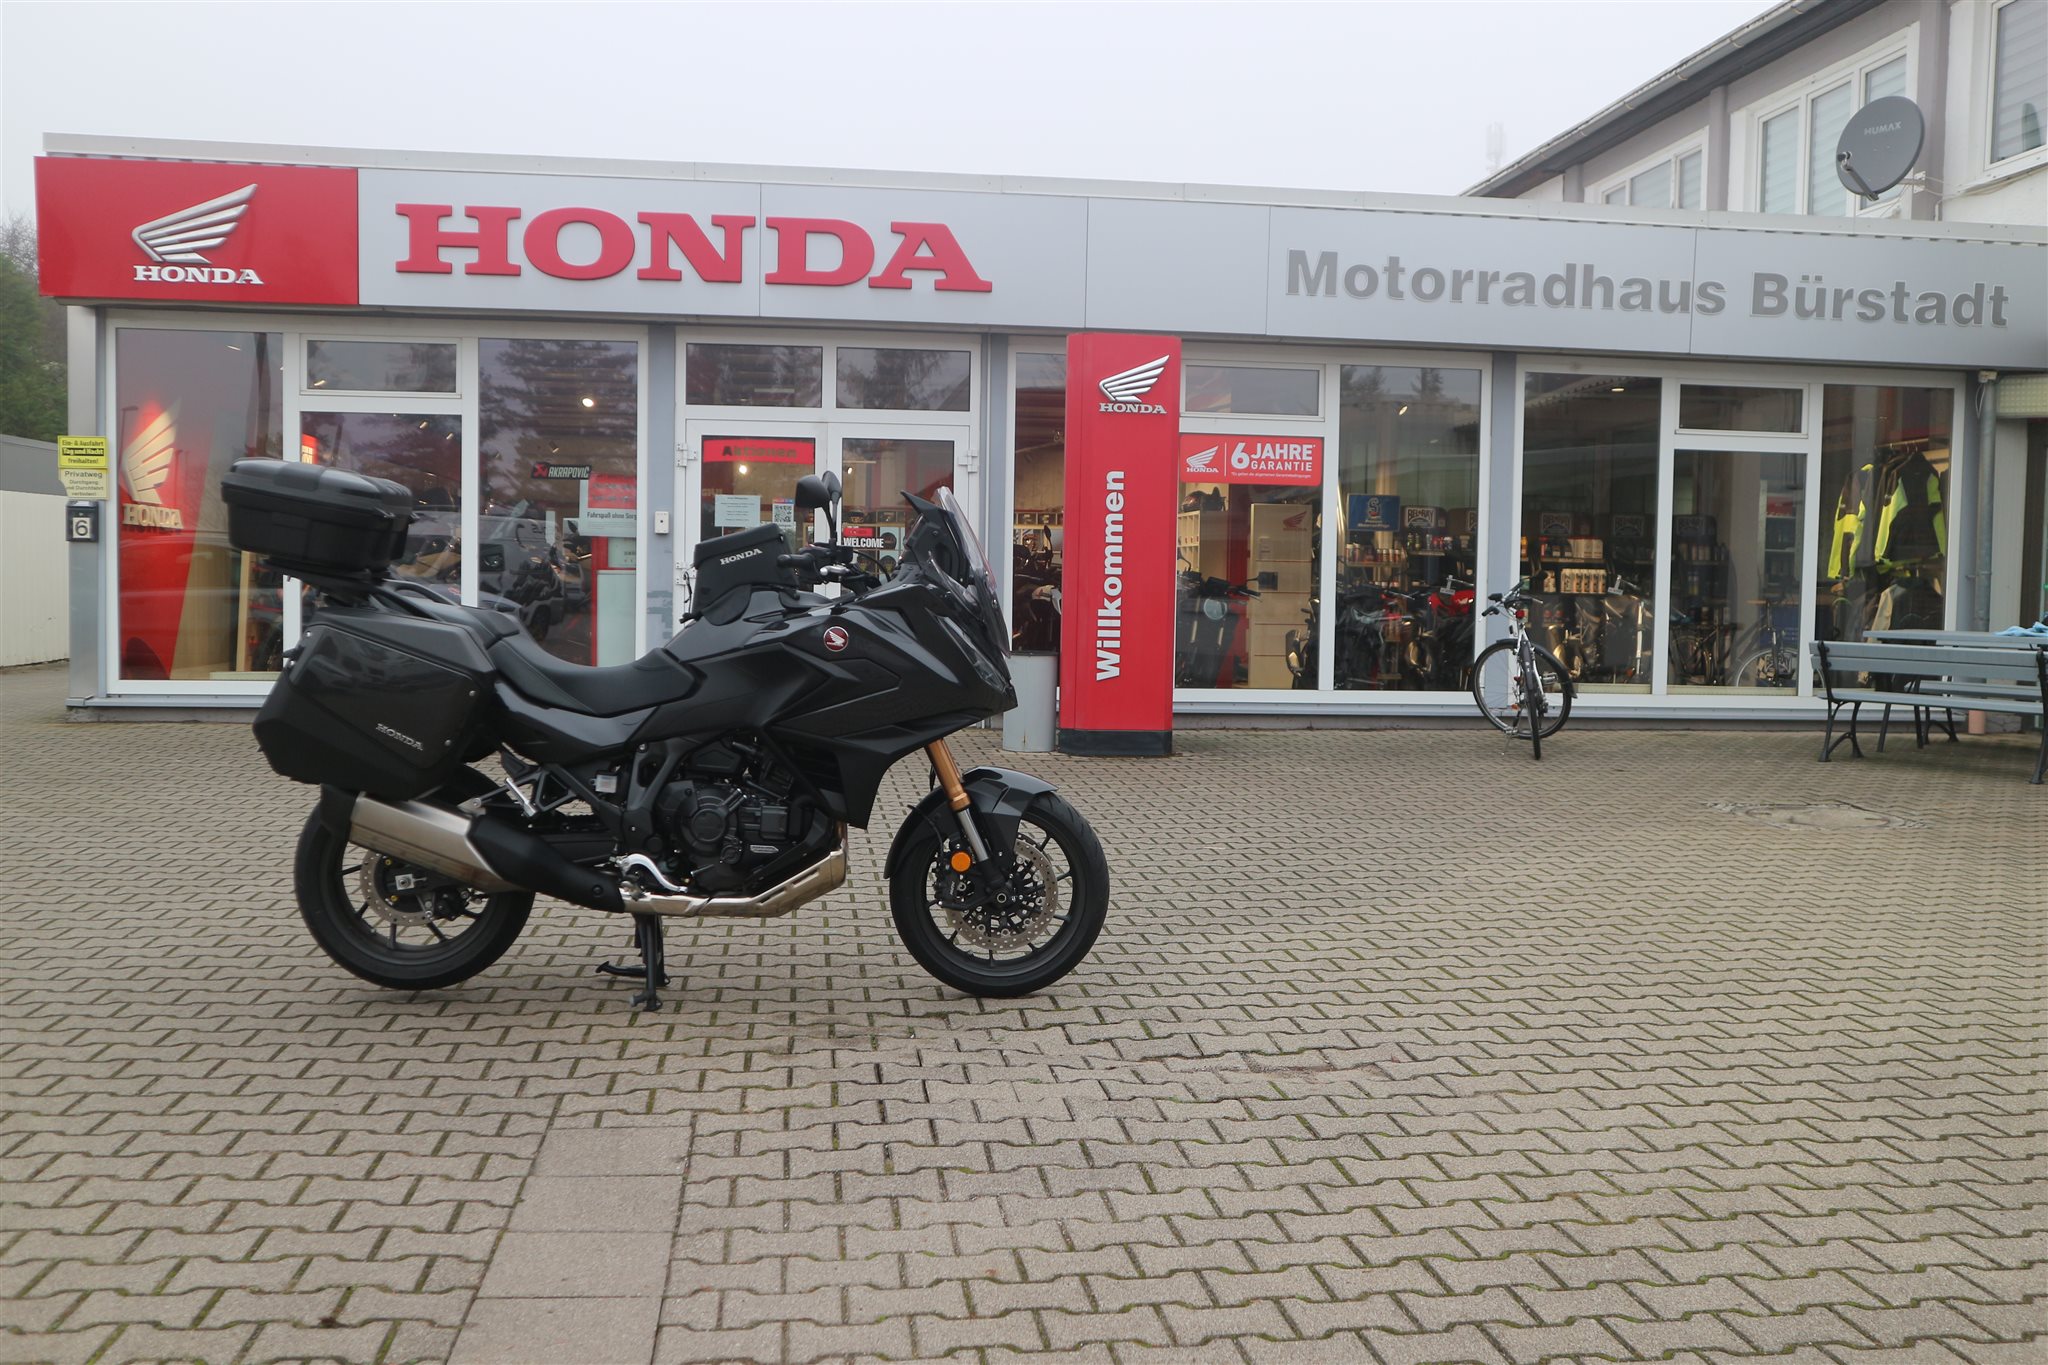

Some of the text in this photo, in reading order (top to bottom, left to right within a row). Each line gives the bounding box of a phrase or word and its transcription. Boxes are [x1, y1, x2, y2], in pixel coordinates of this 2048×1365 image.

[1864, 121, 1902, 135] HUMAX
[396, 203, 992, 292] HONDA
[133, 265, 264, 285] HONDA
[1285, 248, 2010, 328] Motorradhaus Bürstadt
[1099, 402, 1167, 415] HONDA
[723, 446, 797, 458] Aktionen
[1231, 442, 1250, 469] 6
[1251, 460, 1312, 471] GARANTIE
[65, 470, 103, 479] Privatweg
[123, 503, 184, 529] HONDA
[587, 511, 611, 519] Fahrspaß
[75, 520, 88, 536] 6
[843, 537, 884, 548] WELCOME
[720, 549, 763, 565] HONDA
[1096, 471, 1125, 681] Willkommen
[376, 723, 424, 751] HONDA
